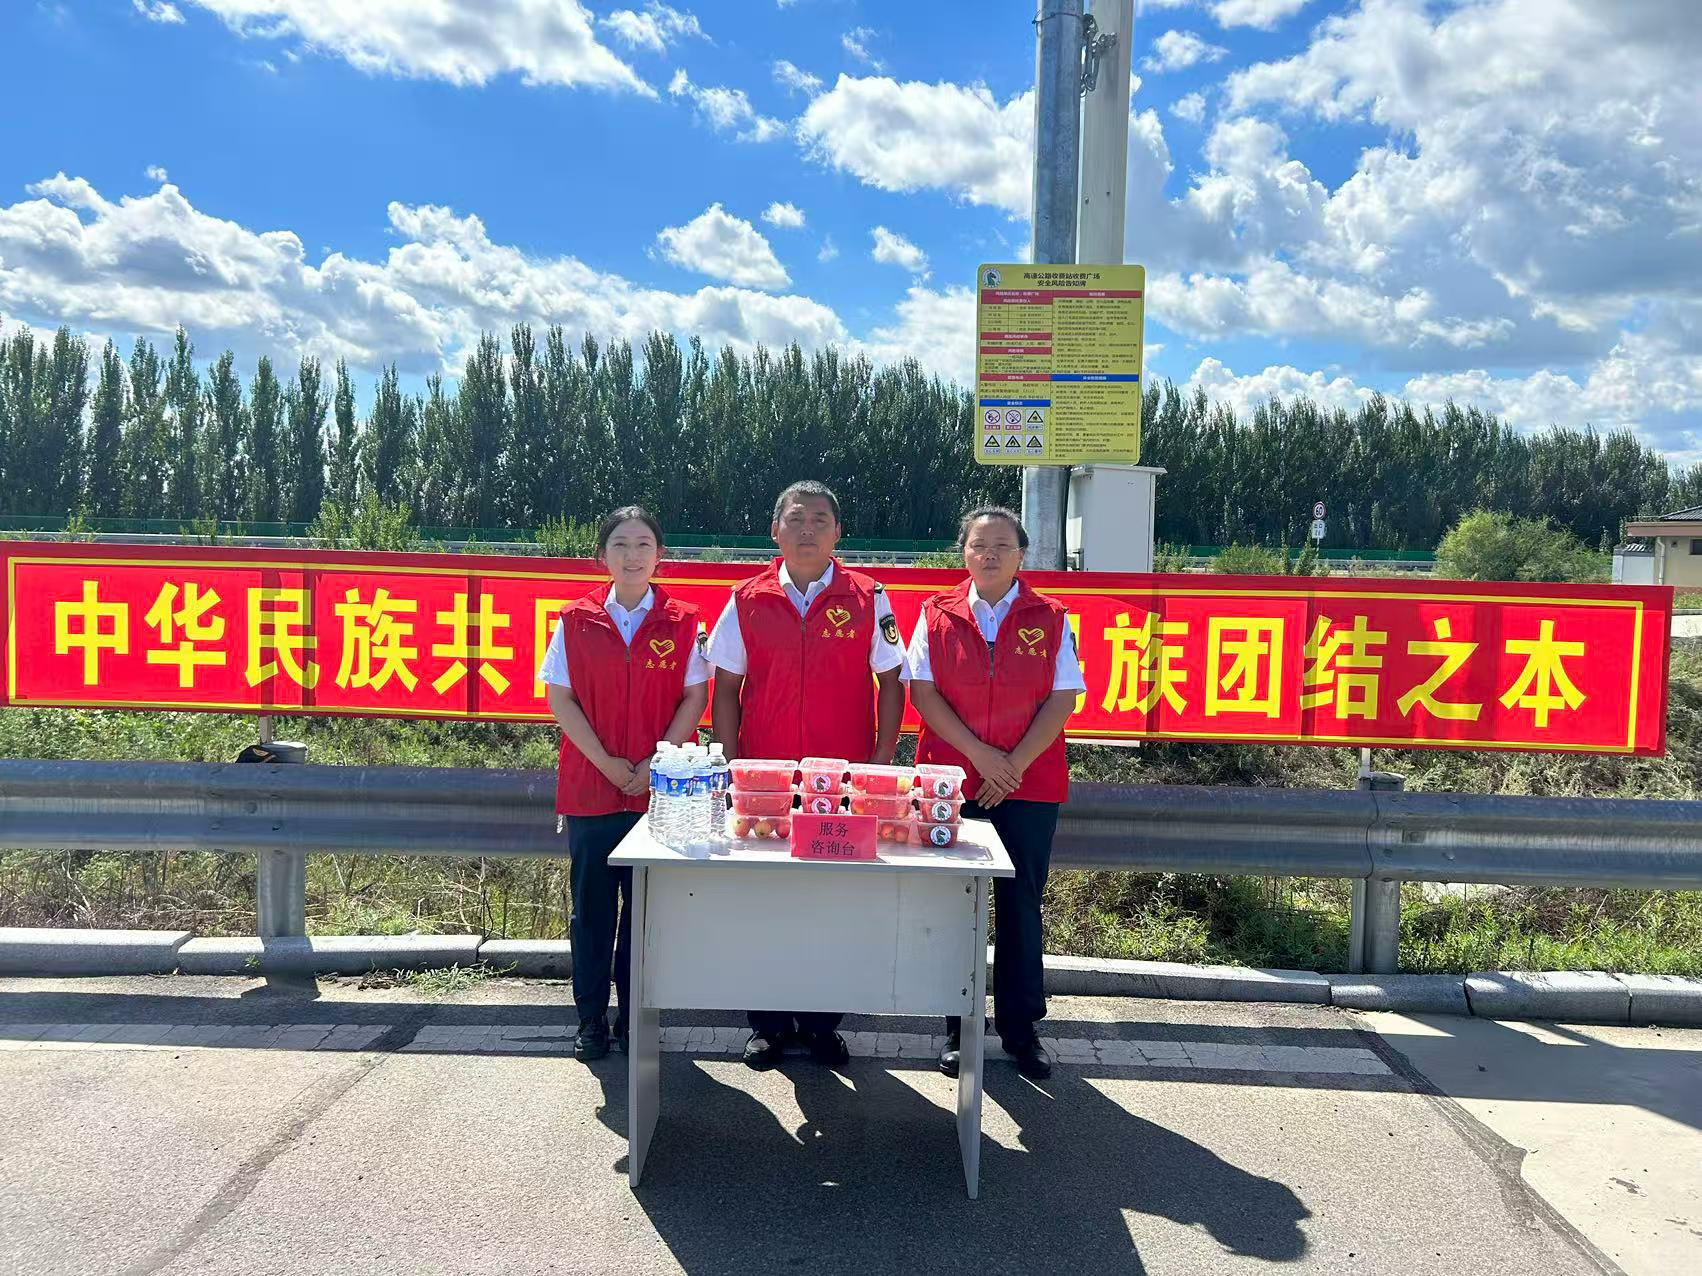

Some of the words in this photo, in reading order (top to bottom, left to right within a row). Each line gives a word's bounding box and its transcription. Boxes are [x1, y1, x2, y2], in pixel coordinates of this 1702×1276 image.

[1023, 272, 1101, 280] 高速公路收费站收费广场
[821, 627, 855, 639] 志愿者
[1014, 646, 1047, 658] 志愿者
[645, 658, 677, 670] 志愿者
[818, 821, 849, 837] 服务
[811, 840, 855, 856] 咨询台
